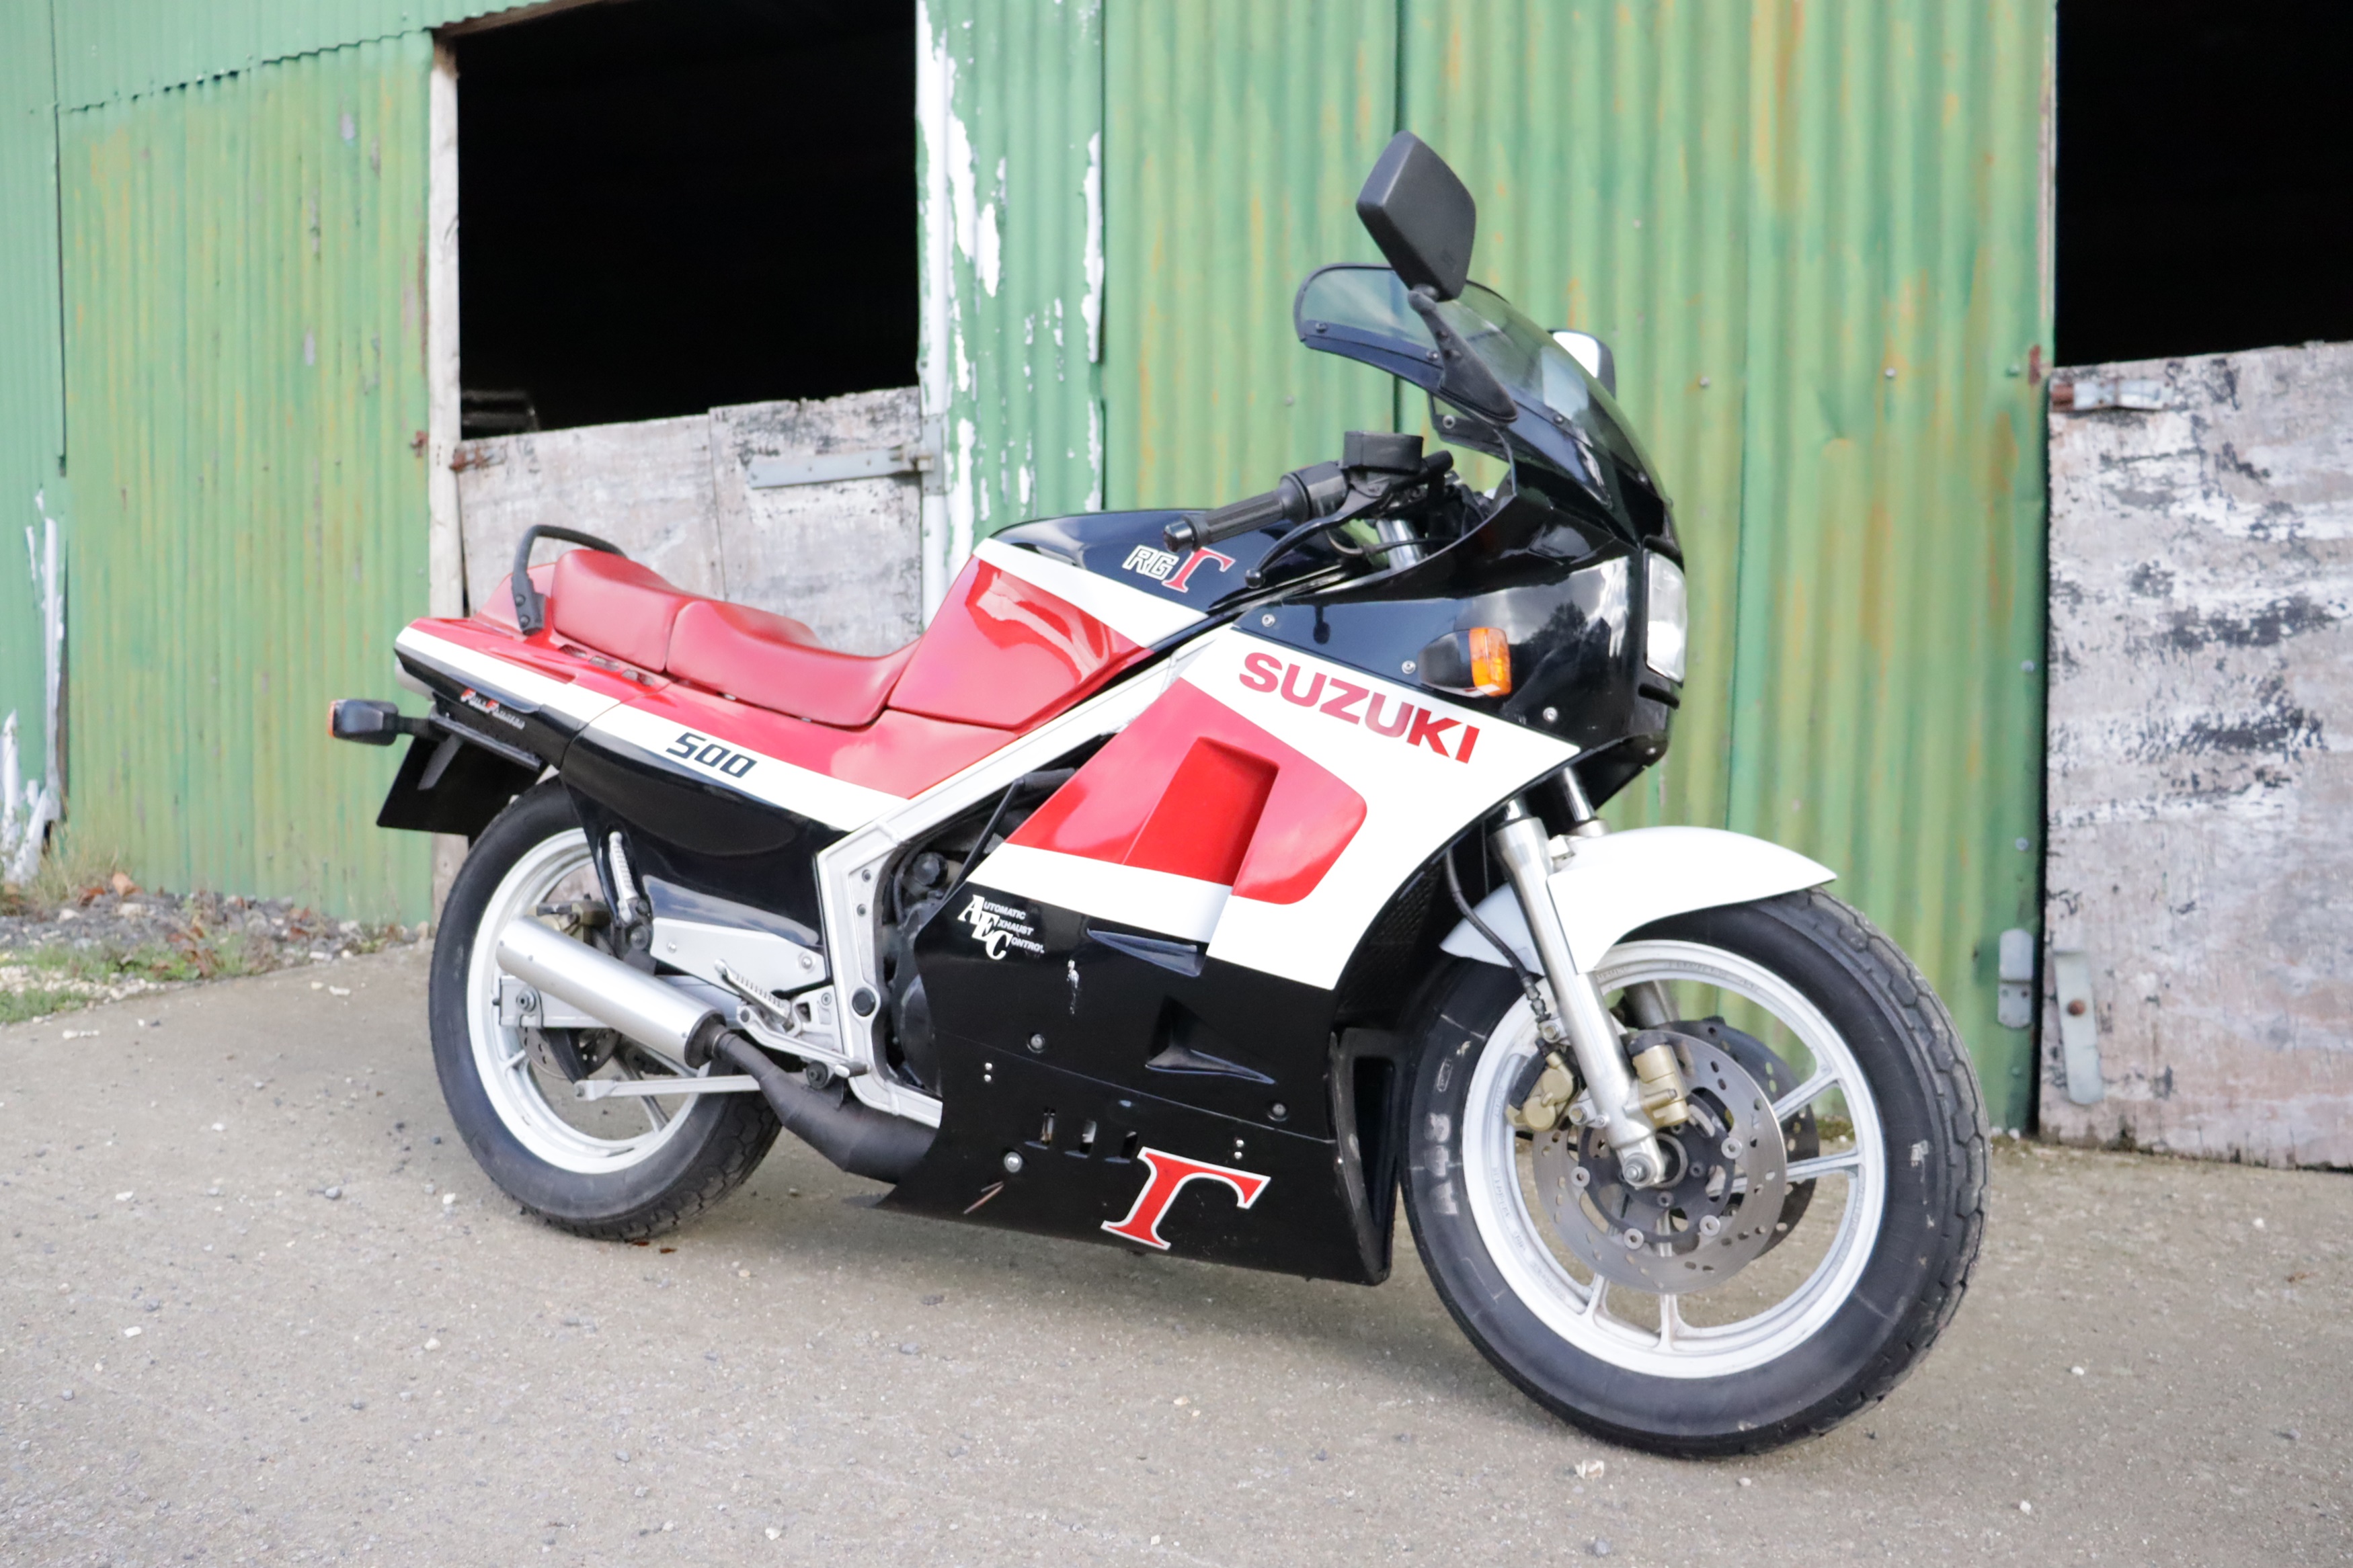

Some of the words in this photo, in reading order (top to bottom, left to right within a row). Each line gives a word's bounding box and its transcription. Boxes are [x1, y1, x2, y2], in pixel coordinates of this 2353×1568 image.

[1239, 652, 1480, 764] SUZUKI
[666, 732, 758, 778] 500
[957, 894, 1026, 925] AUTOMATIC
[971, 910, 1034, 942] EXHAUST
[986, 930, 1045, 960] CONTROL
